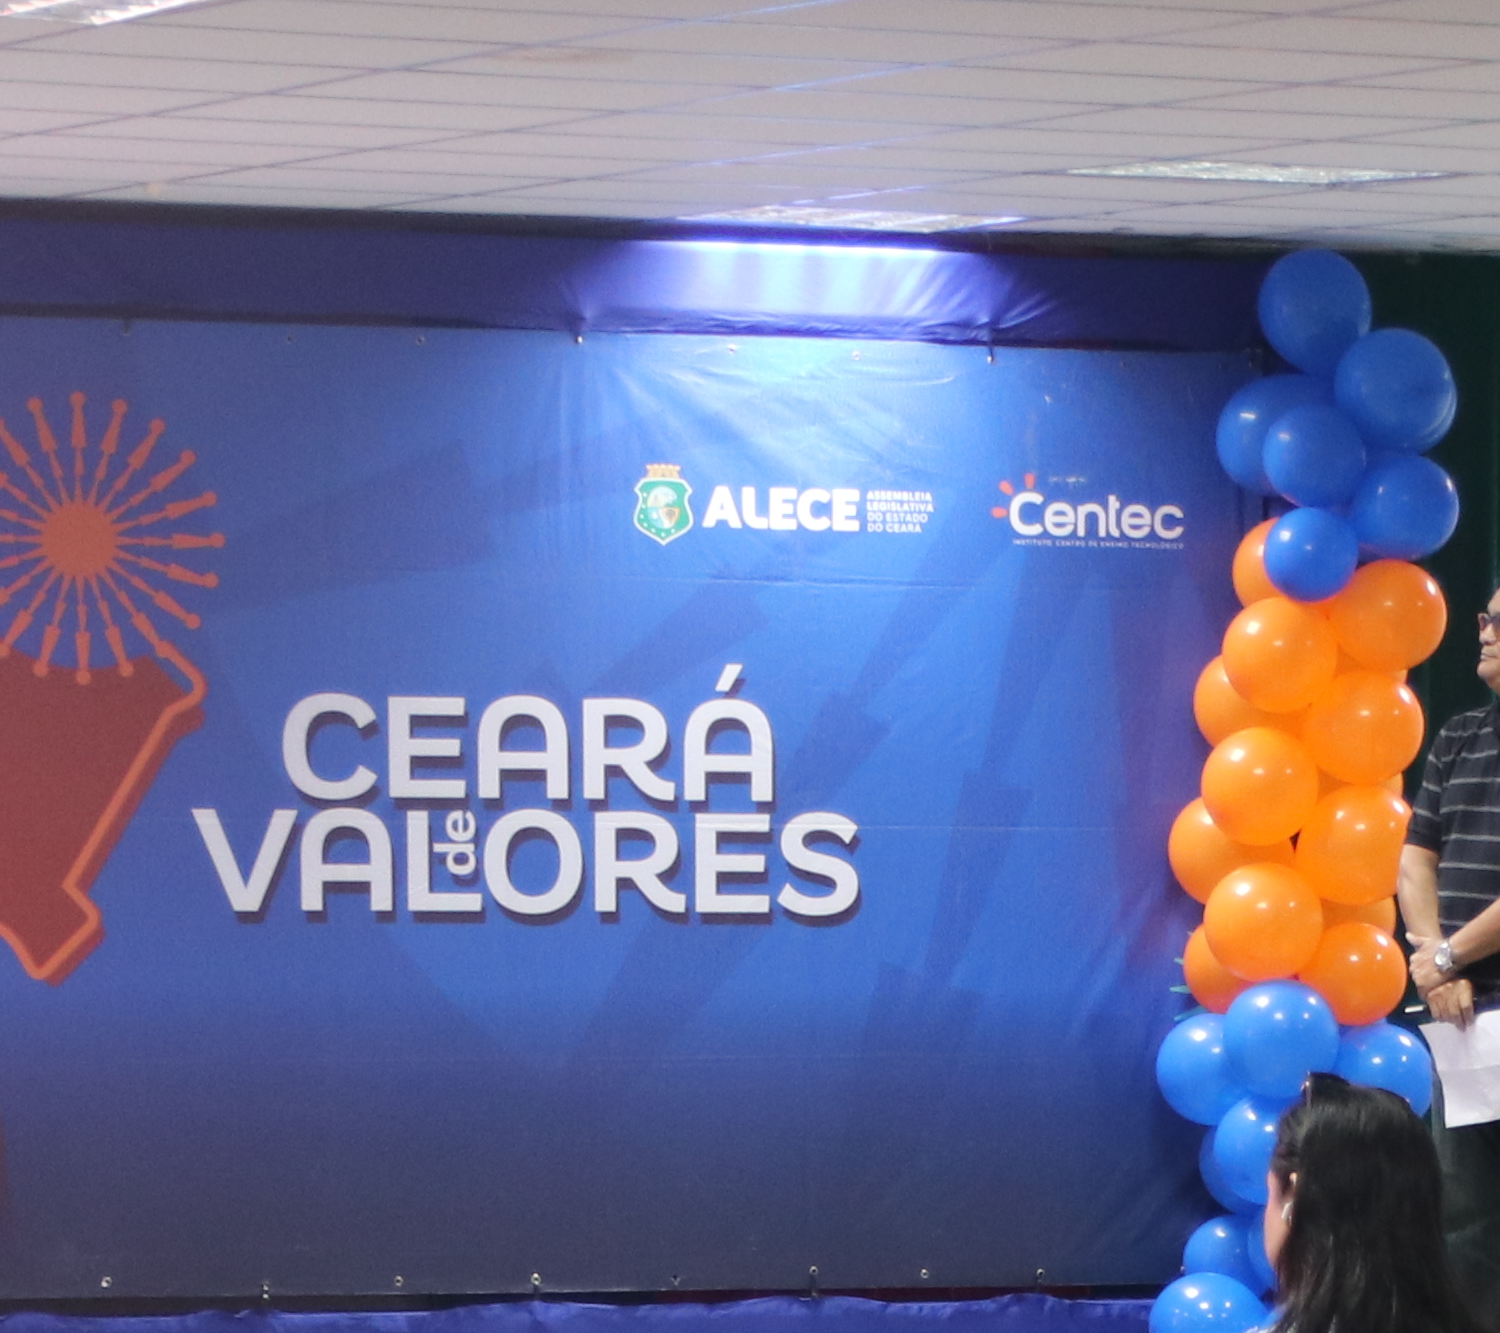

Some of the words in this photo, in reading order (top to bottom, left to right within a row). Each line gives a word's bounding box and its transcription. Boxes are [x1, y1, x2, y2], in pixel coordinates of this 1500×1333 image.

[701, 485, 861, 532] ALECE
[866, 490, 933, 502] ASSEMBLEIA
[866, 501, 935, 512] LEGISLATIVA
[866, 512, 883, 522] DO
[885, 512, 929, 523] ESTADO
[1008, 491, 1185, 539] Centec
[866, 522, 883, 532] DO
[885, 521, 922, 533] CEARÁ
[282, 664, 774, 802] CEARÁ
[191, 807, 860, 917] VALORES
[432, 810, 477, 877] de
